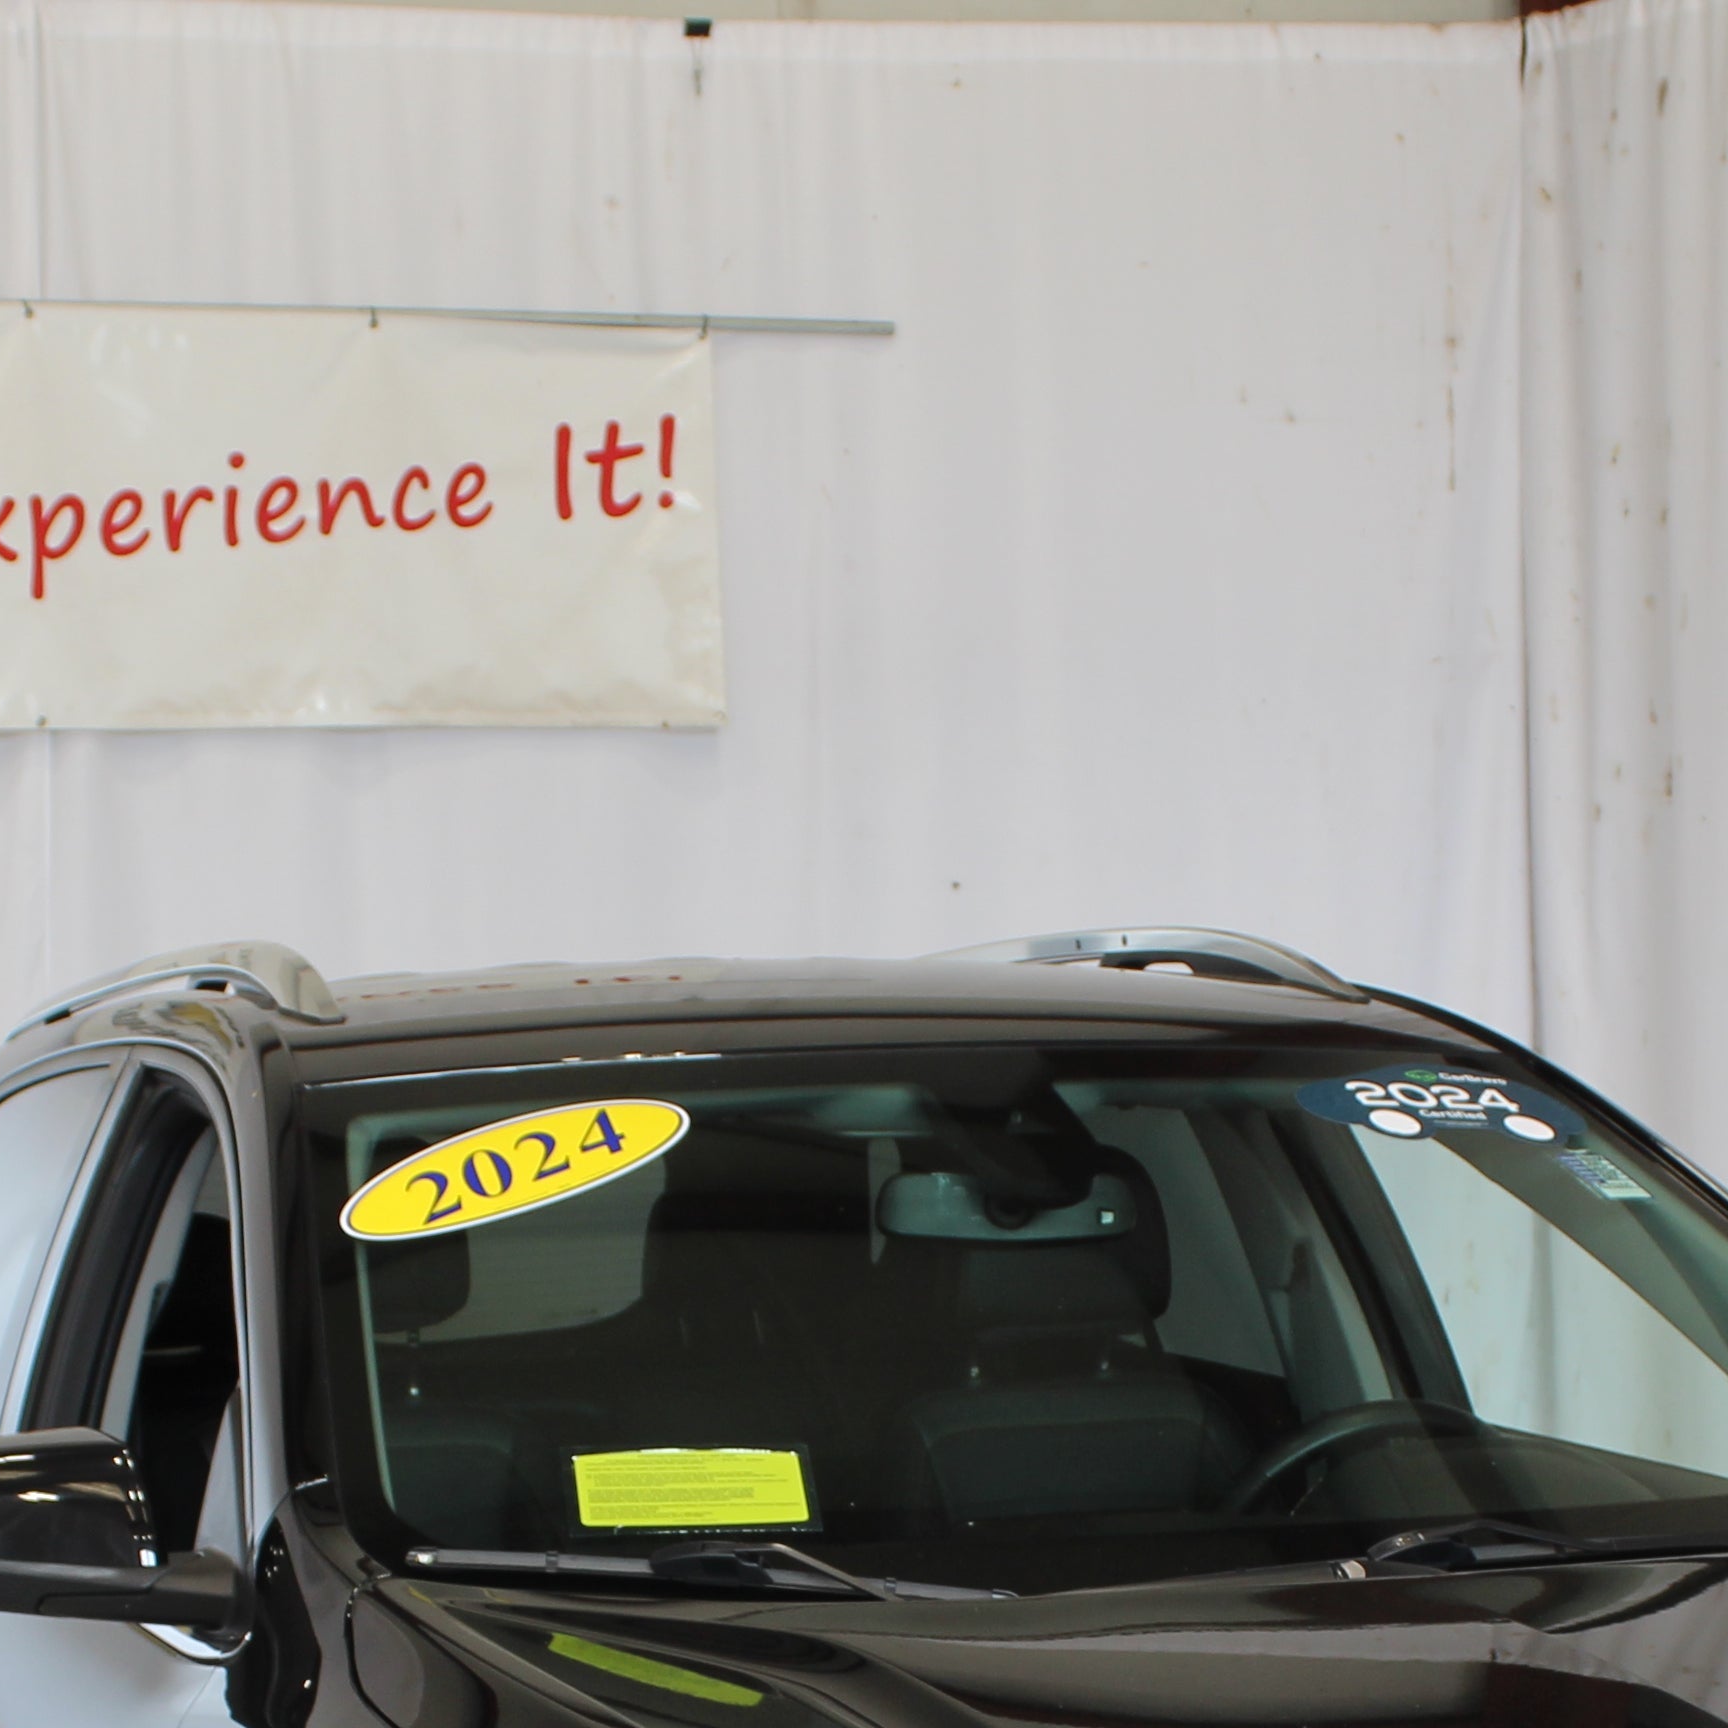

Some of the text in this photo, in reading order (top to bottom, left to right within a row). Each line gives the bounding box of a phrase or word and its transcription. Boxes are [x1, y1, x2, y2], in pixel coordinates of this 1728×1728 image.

[555, 415, 677, 521] It!
[1344, 1080, 1520, 1113] 2024
[406, 1108, 626, 1225] 2024
